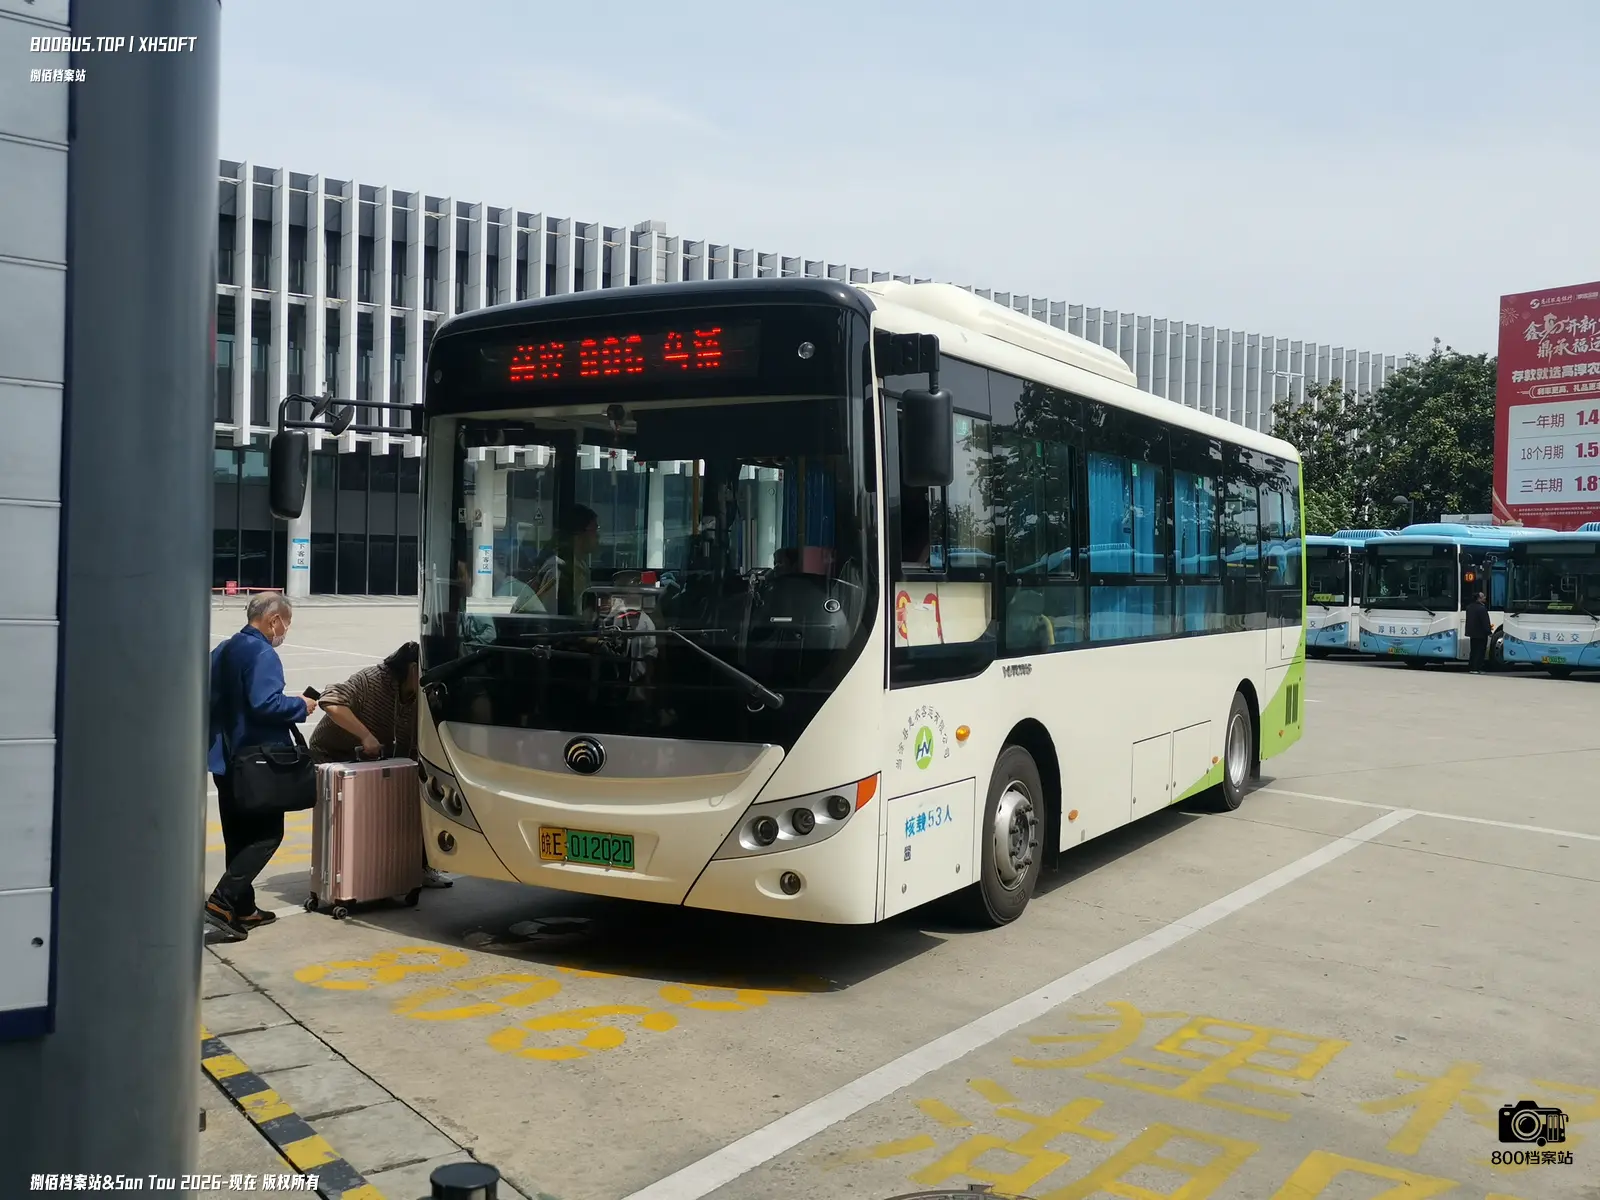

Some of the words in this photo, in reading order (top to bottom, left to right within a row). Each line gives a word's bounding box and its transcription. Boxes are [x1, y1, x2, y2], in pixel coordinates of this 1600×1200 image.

[1522, 413, 1565, 428] 一年期
[1521, 445, 1564, 460] 18个月期
[1520, 478, 1563, 493] 三年期
[1574, 475, 1600, 492] 1.8
